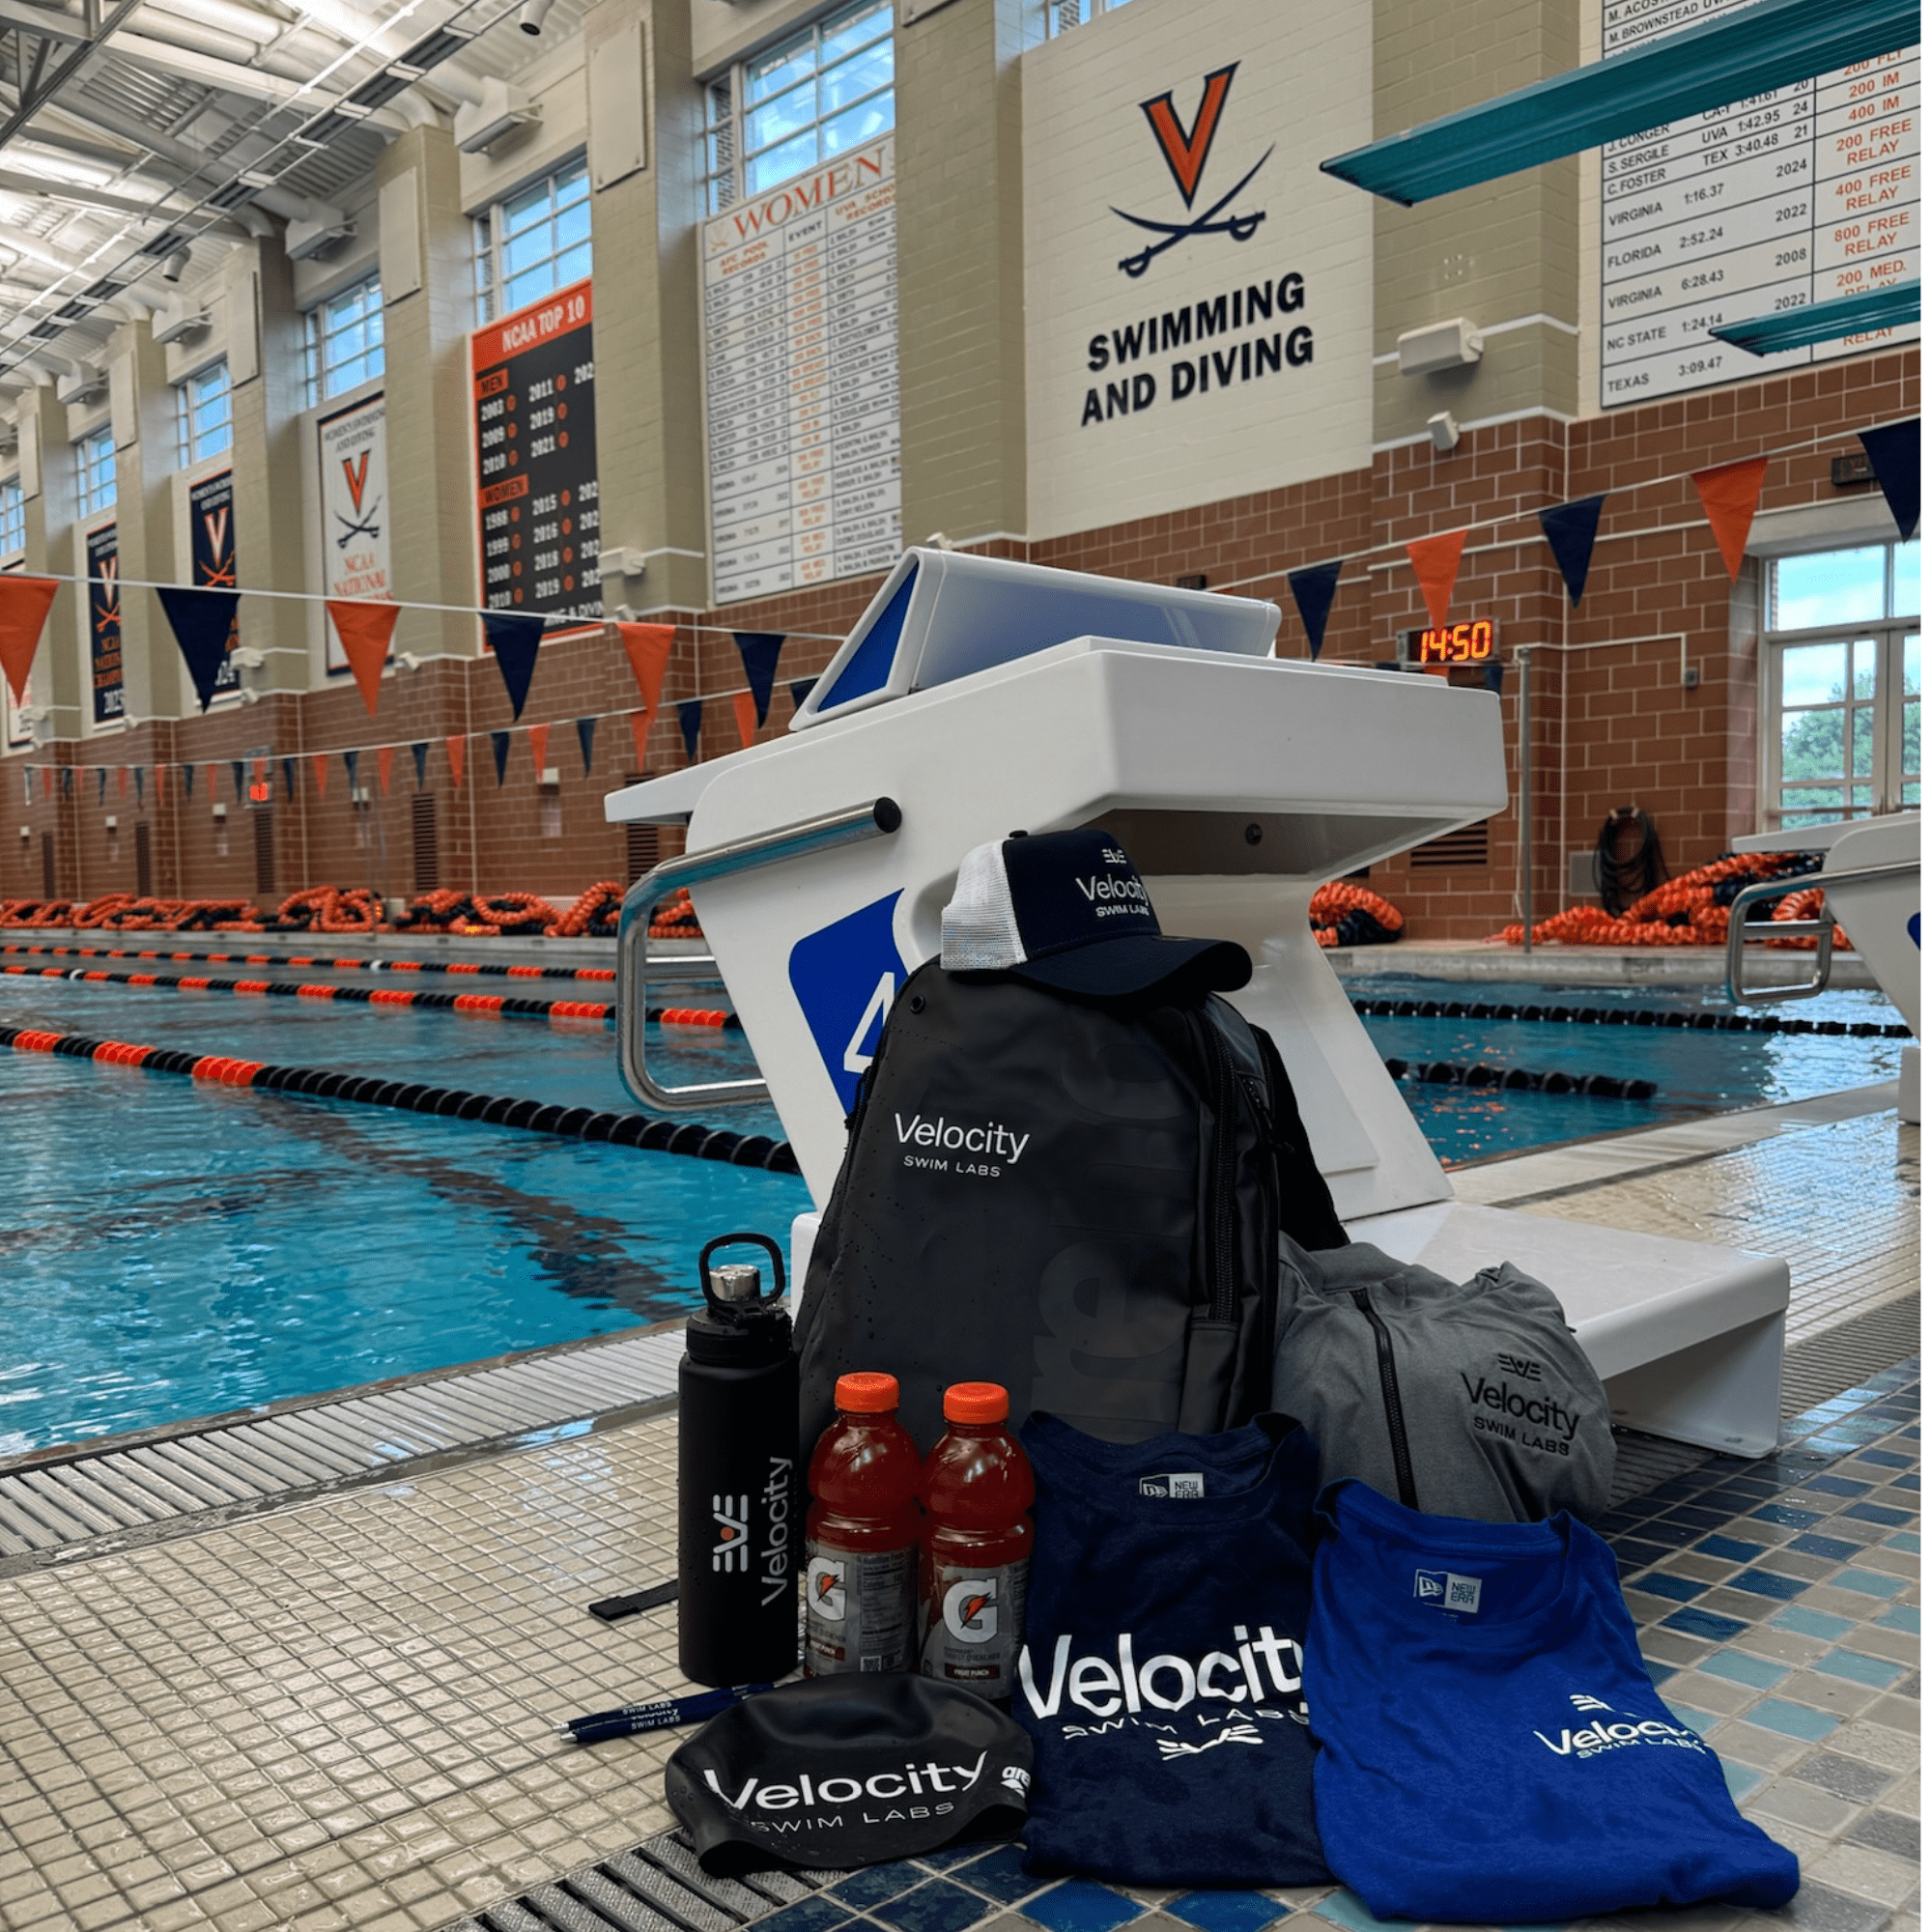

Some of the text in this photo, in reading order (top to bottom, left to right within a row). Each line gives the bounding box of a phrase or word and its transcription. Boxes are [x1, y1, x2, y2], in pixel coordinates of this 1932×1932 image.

[1608, 10, 1621, 23] M.
[1608, 33, 1620, 44] M.
[1622, 3, 1699, 40] BROWNSTEAD
[1793, 79, 1809, 93] 20
[1849, 71, 1900, 98] 200 IM
[1849, 95, 1900, 121] 400 IM
[1608, 100, 1808, 174] S. SERGILE UVA 1:42.95 24
[1836, 118, 1912, 152] 200 FREE
[1847, 139, 1899, 165] RELAY
[1607, 125, 1808, 196] C. FOSTER TEX 3:40.48 21
[1835, 164, 1912, 196] 400 FREE
[733, 147, 885, 240] WOMEN
[1608, 158, 1807, 227] VIRGINIA 1:16.37 2024
[1846, 185, 1899, 211] RELAY
[1607, 203, 1807, 269] FLORIDA 2:52.24 2022
[1834, 212, 1910, 242] 800 FREE
[1845, 231, 1898, 256] RELAY
[1608, 247, 1806, 310] VIRGINIA 6:28.43 2008
[1836, 270, 1862, 287] 200
[502, 295, 585, 354] NCAA TOP 10
[1088, 271, 1304, 372] SWIMMING
[1607, 292, 1806, 352] NC STATE 1:24.14 2022
[1081, 326, 1314, 427] AND DIVING
[1607, 355, 1722, 393] TEXAS 3:09.47
[1421, 620, 1492, 664] 14:50
[843, 971, 895, 1074] 4
[895, 1112, 1031, 1165] Velocity
[903, 1154, 1002, 1179] SWIM LABS
[1461, 1372, 1580, 1441] Velocity
[1474, 1415, 1570, 1457] SWIM LABS
[1175, 1481, 1198, 1490] NEW
[760, 1456, 793, 1606] Velocity
[1451, 1592, 1474, 1605] ERA
[1452, 1581, 1476, 1595] NEW
[943, 1576, 998, 1643] G
[631, 1715, 681, 1730] SWIM LABS
[703, 1749, 988, 1810] Velocity
[1002, 1766, 1031, 1790] are
[750, 1802, 954, 1833] SWIM LABS
